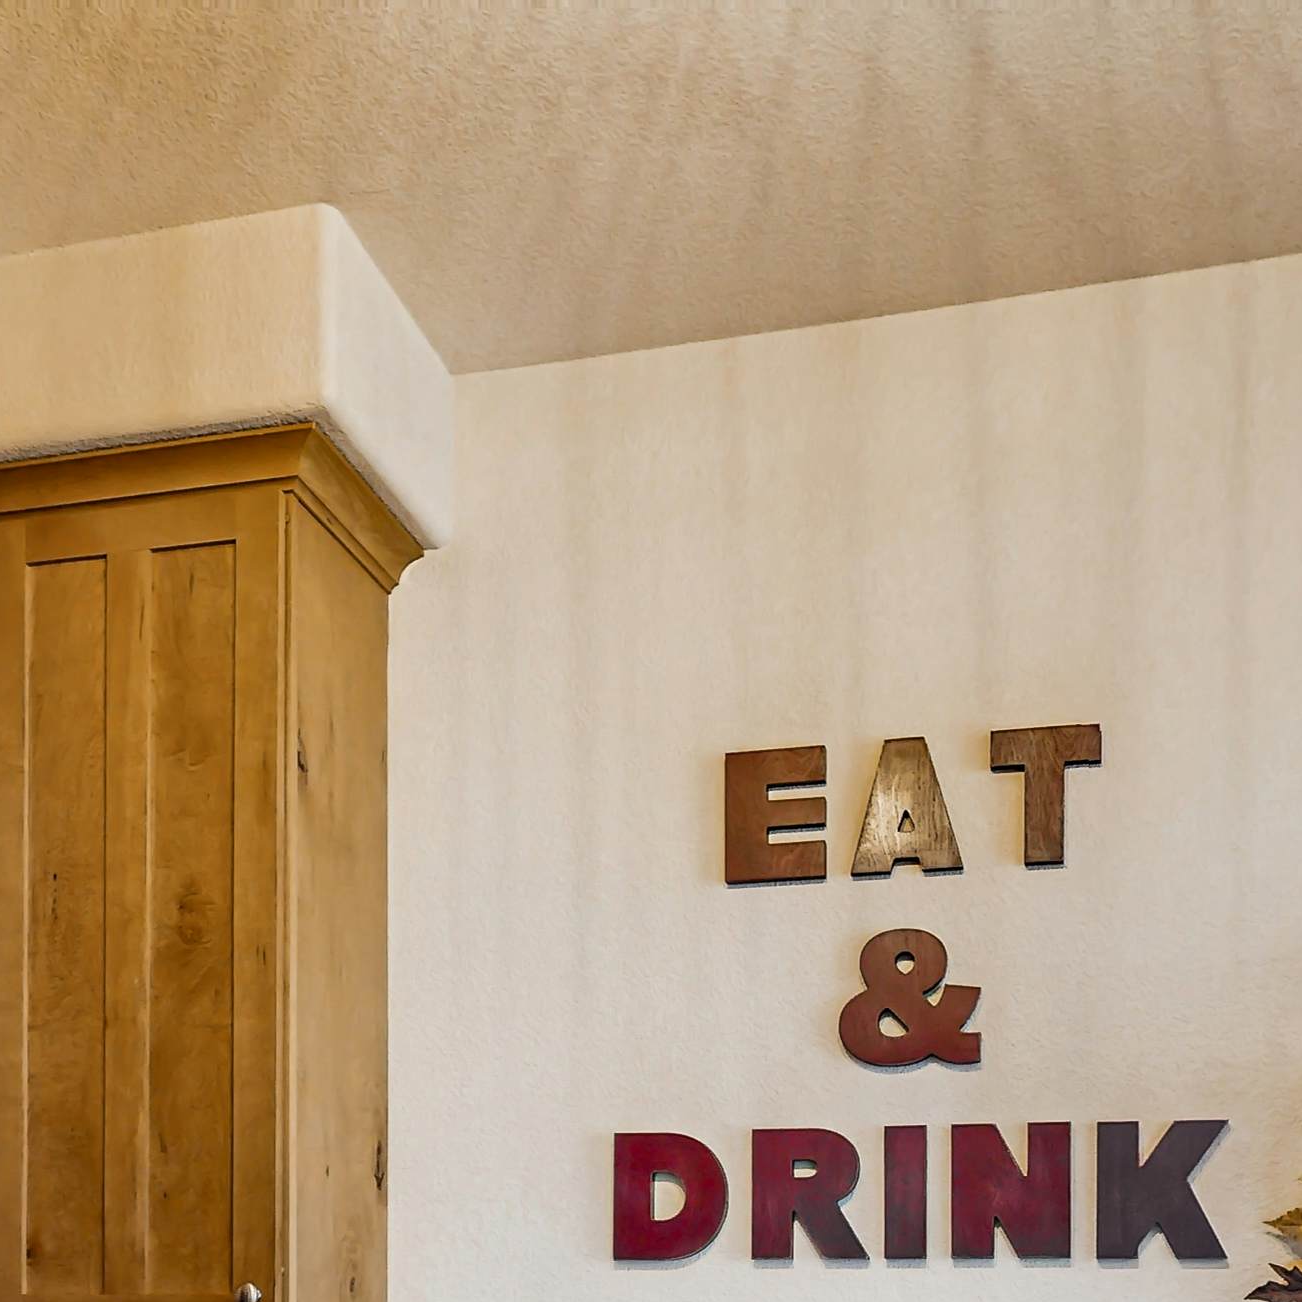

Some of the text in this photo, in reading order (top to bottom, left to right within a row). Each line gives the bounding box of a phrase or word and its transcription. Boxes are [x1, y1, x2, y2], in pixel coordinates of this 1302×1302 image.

[724, 723, 1102, 887] EAT
[838, 927, 982, 1070] &
[612, 1119, 1230, 1266] DRINK
